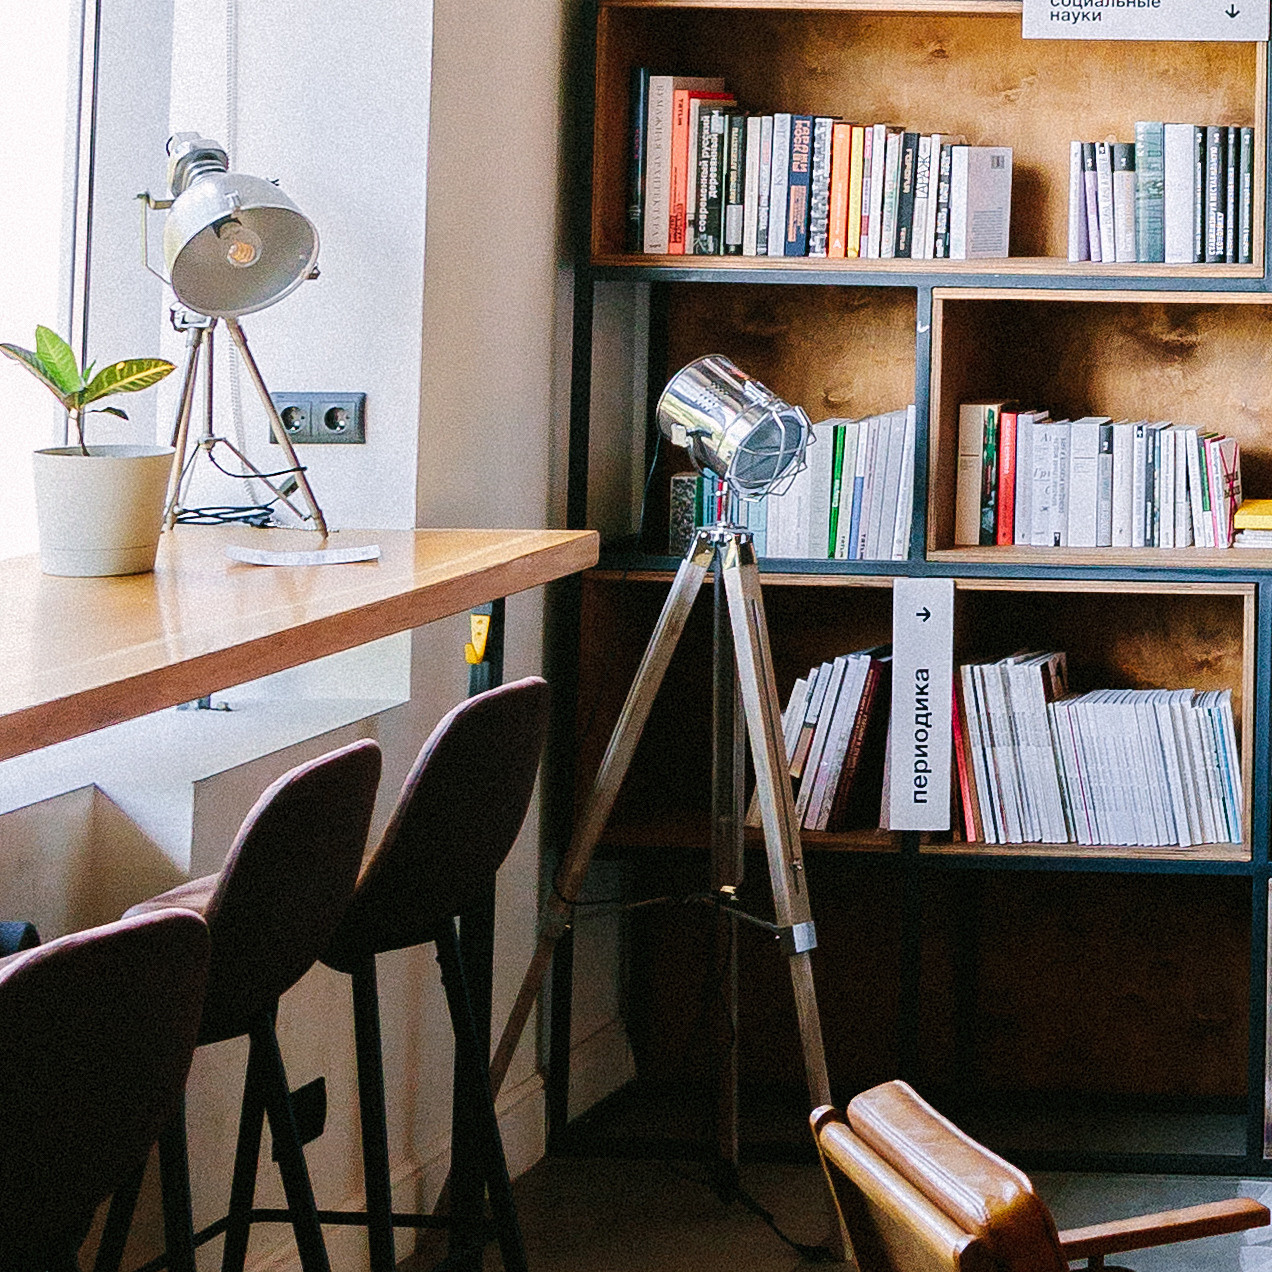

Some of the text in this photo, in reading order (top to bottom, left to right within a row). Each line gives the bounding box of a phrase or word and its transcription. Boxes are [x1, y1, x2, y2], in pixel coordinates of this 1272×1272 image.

[1050, 10, 1102, 25] науки
[698, 115, 712, 233] современный русский
[913, 668, 932, 804] периодика
